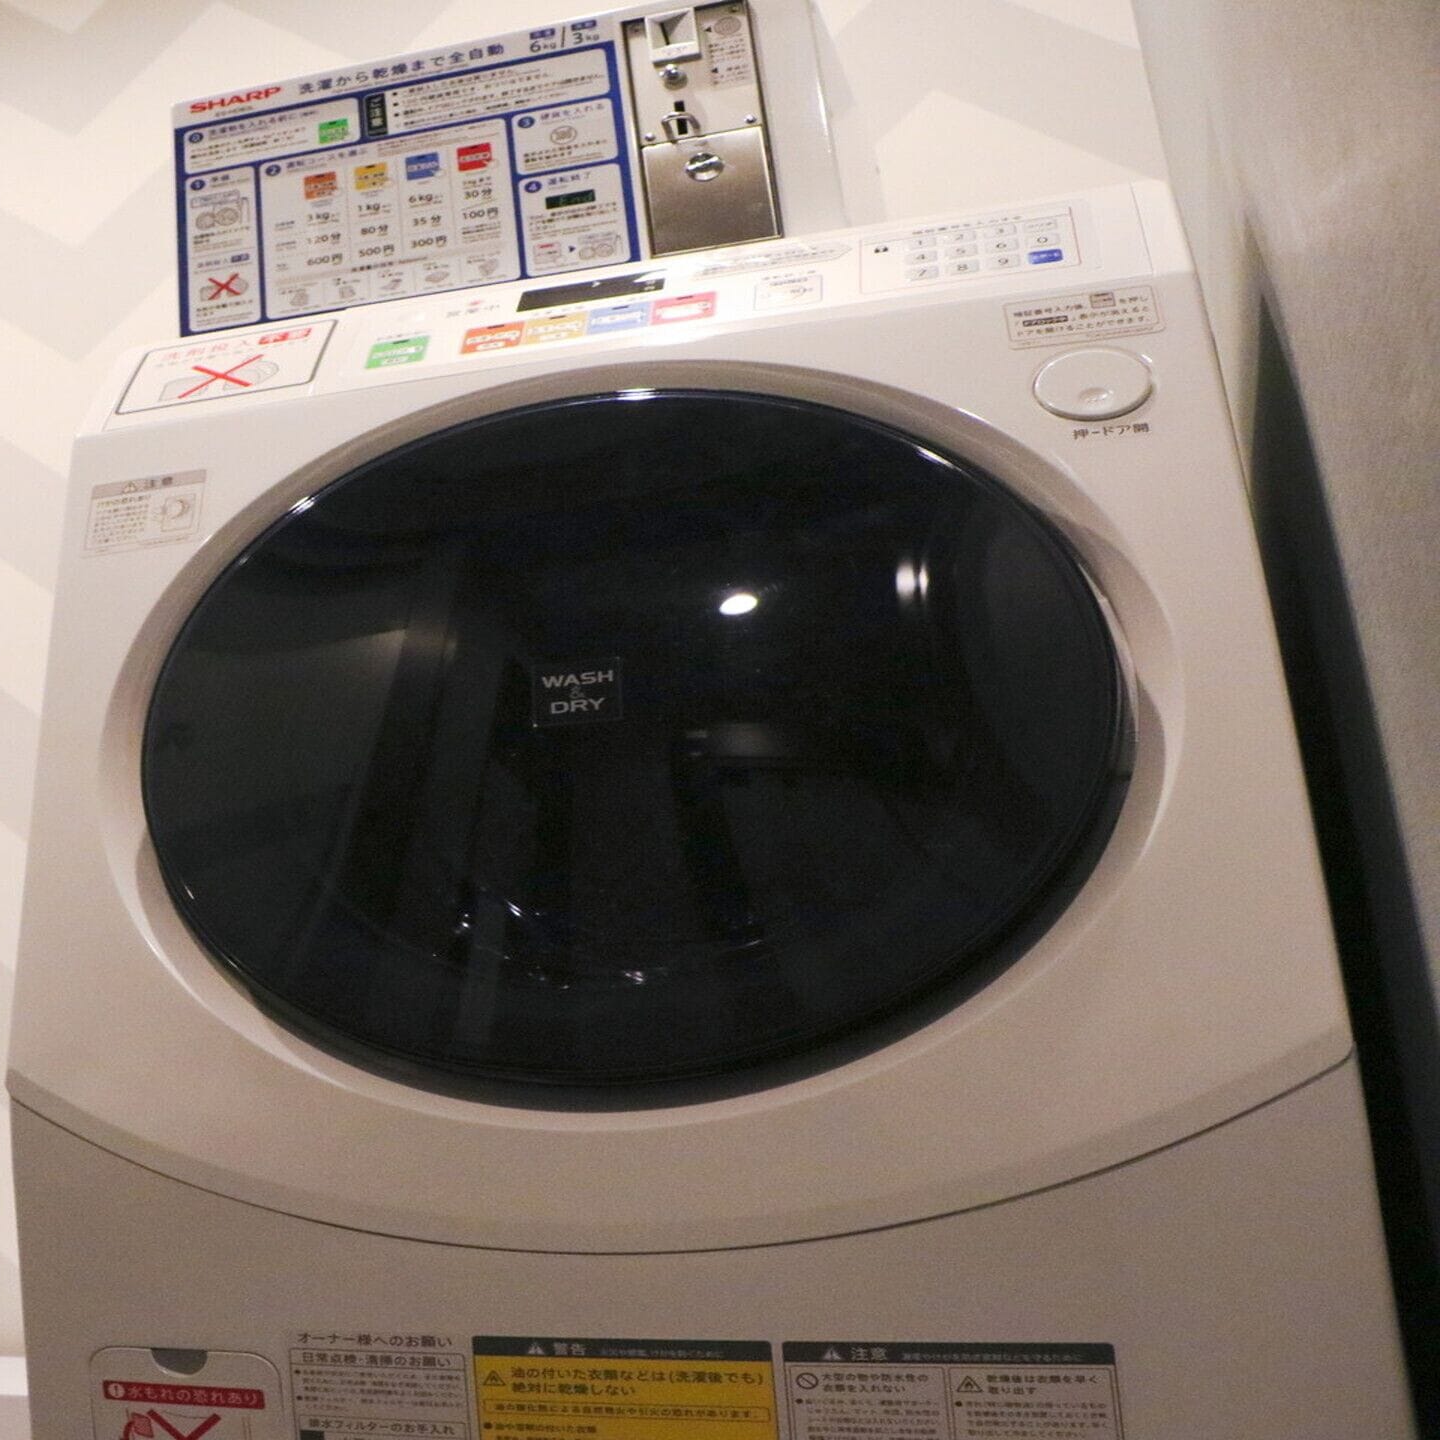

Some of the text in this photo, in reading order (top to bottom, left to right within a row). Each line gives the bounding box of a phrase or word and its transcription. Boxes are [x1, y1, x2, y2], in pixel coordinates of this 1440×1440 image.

[298, 43, 505, 95] 洗濯から乾燥まで全自動
[190, 87, 281, 114] SHARP
[541, 669, 614, 688] WASH
[550, 697, 606, 714] DRY
[297, 1332, 453, 1348] オーナー様へのお願い
[126, 1386, 258, 1406] 水もれの恐れあり
